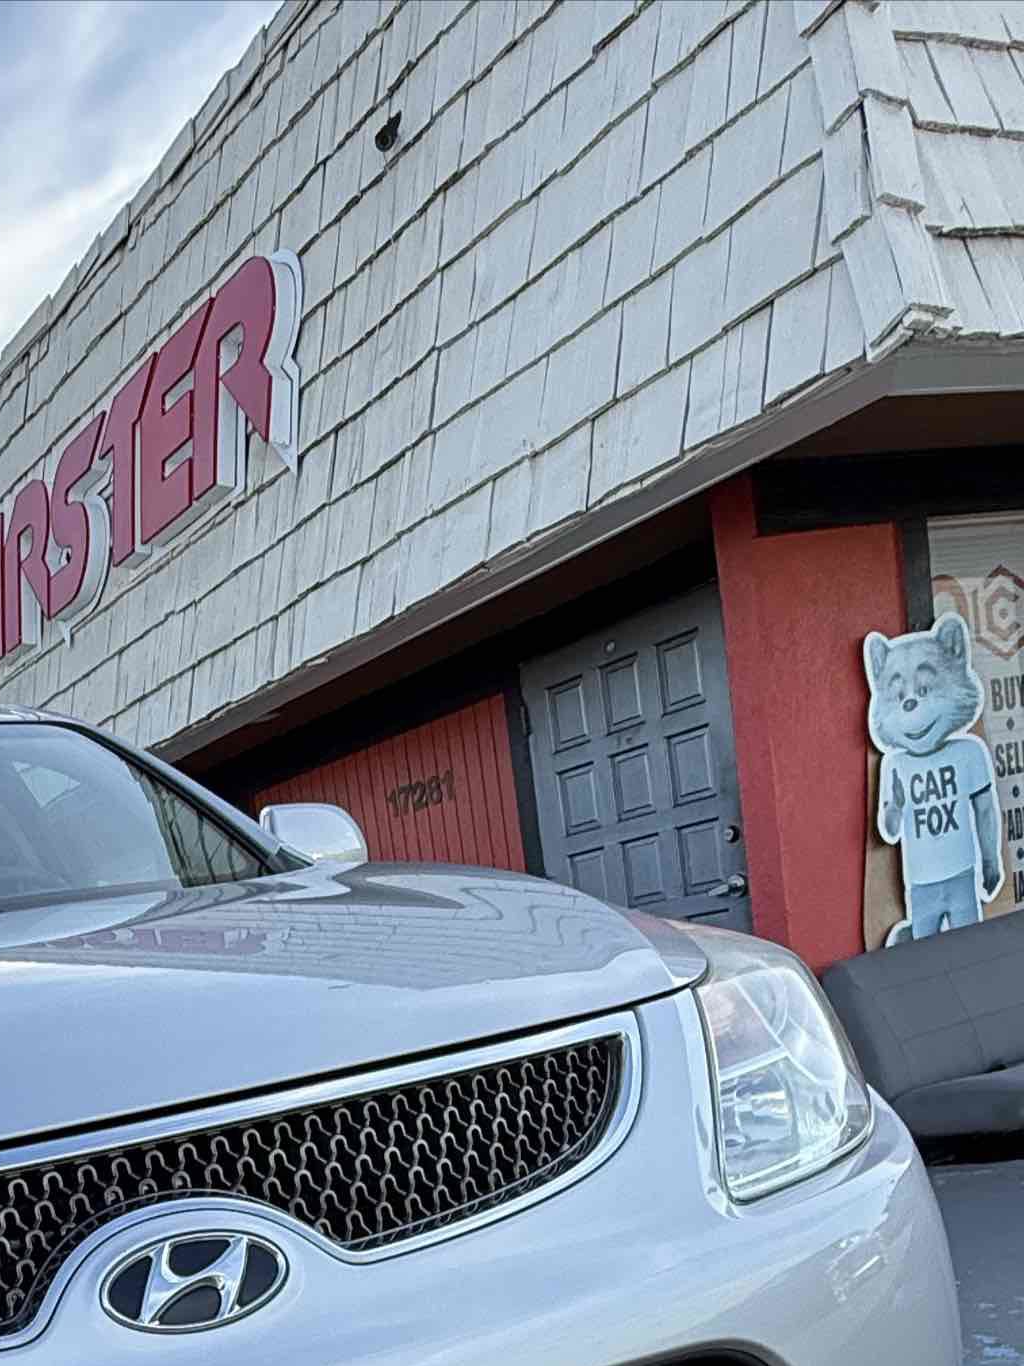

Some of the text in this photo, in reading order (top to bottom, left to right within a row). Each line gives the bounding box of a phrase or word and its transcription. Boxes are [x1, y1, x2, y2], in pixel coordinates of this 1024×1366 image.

[995, 739, 1024, 779] SEL
[386, 767, 455, 818] 17281
[910, 764, 957, 805] CAR
[913, 799, 960, 840] FOX
